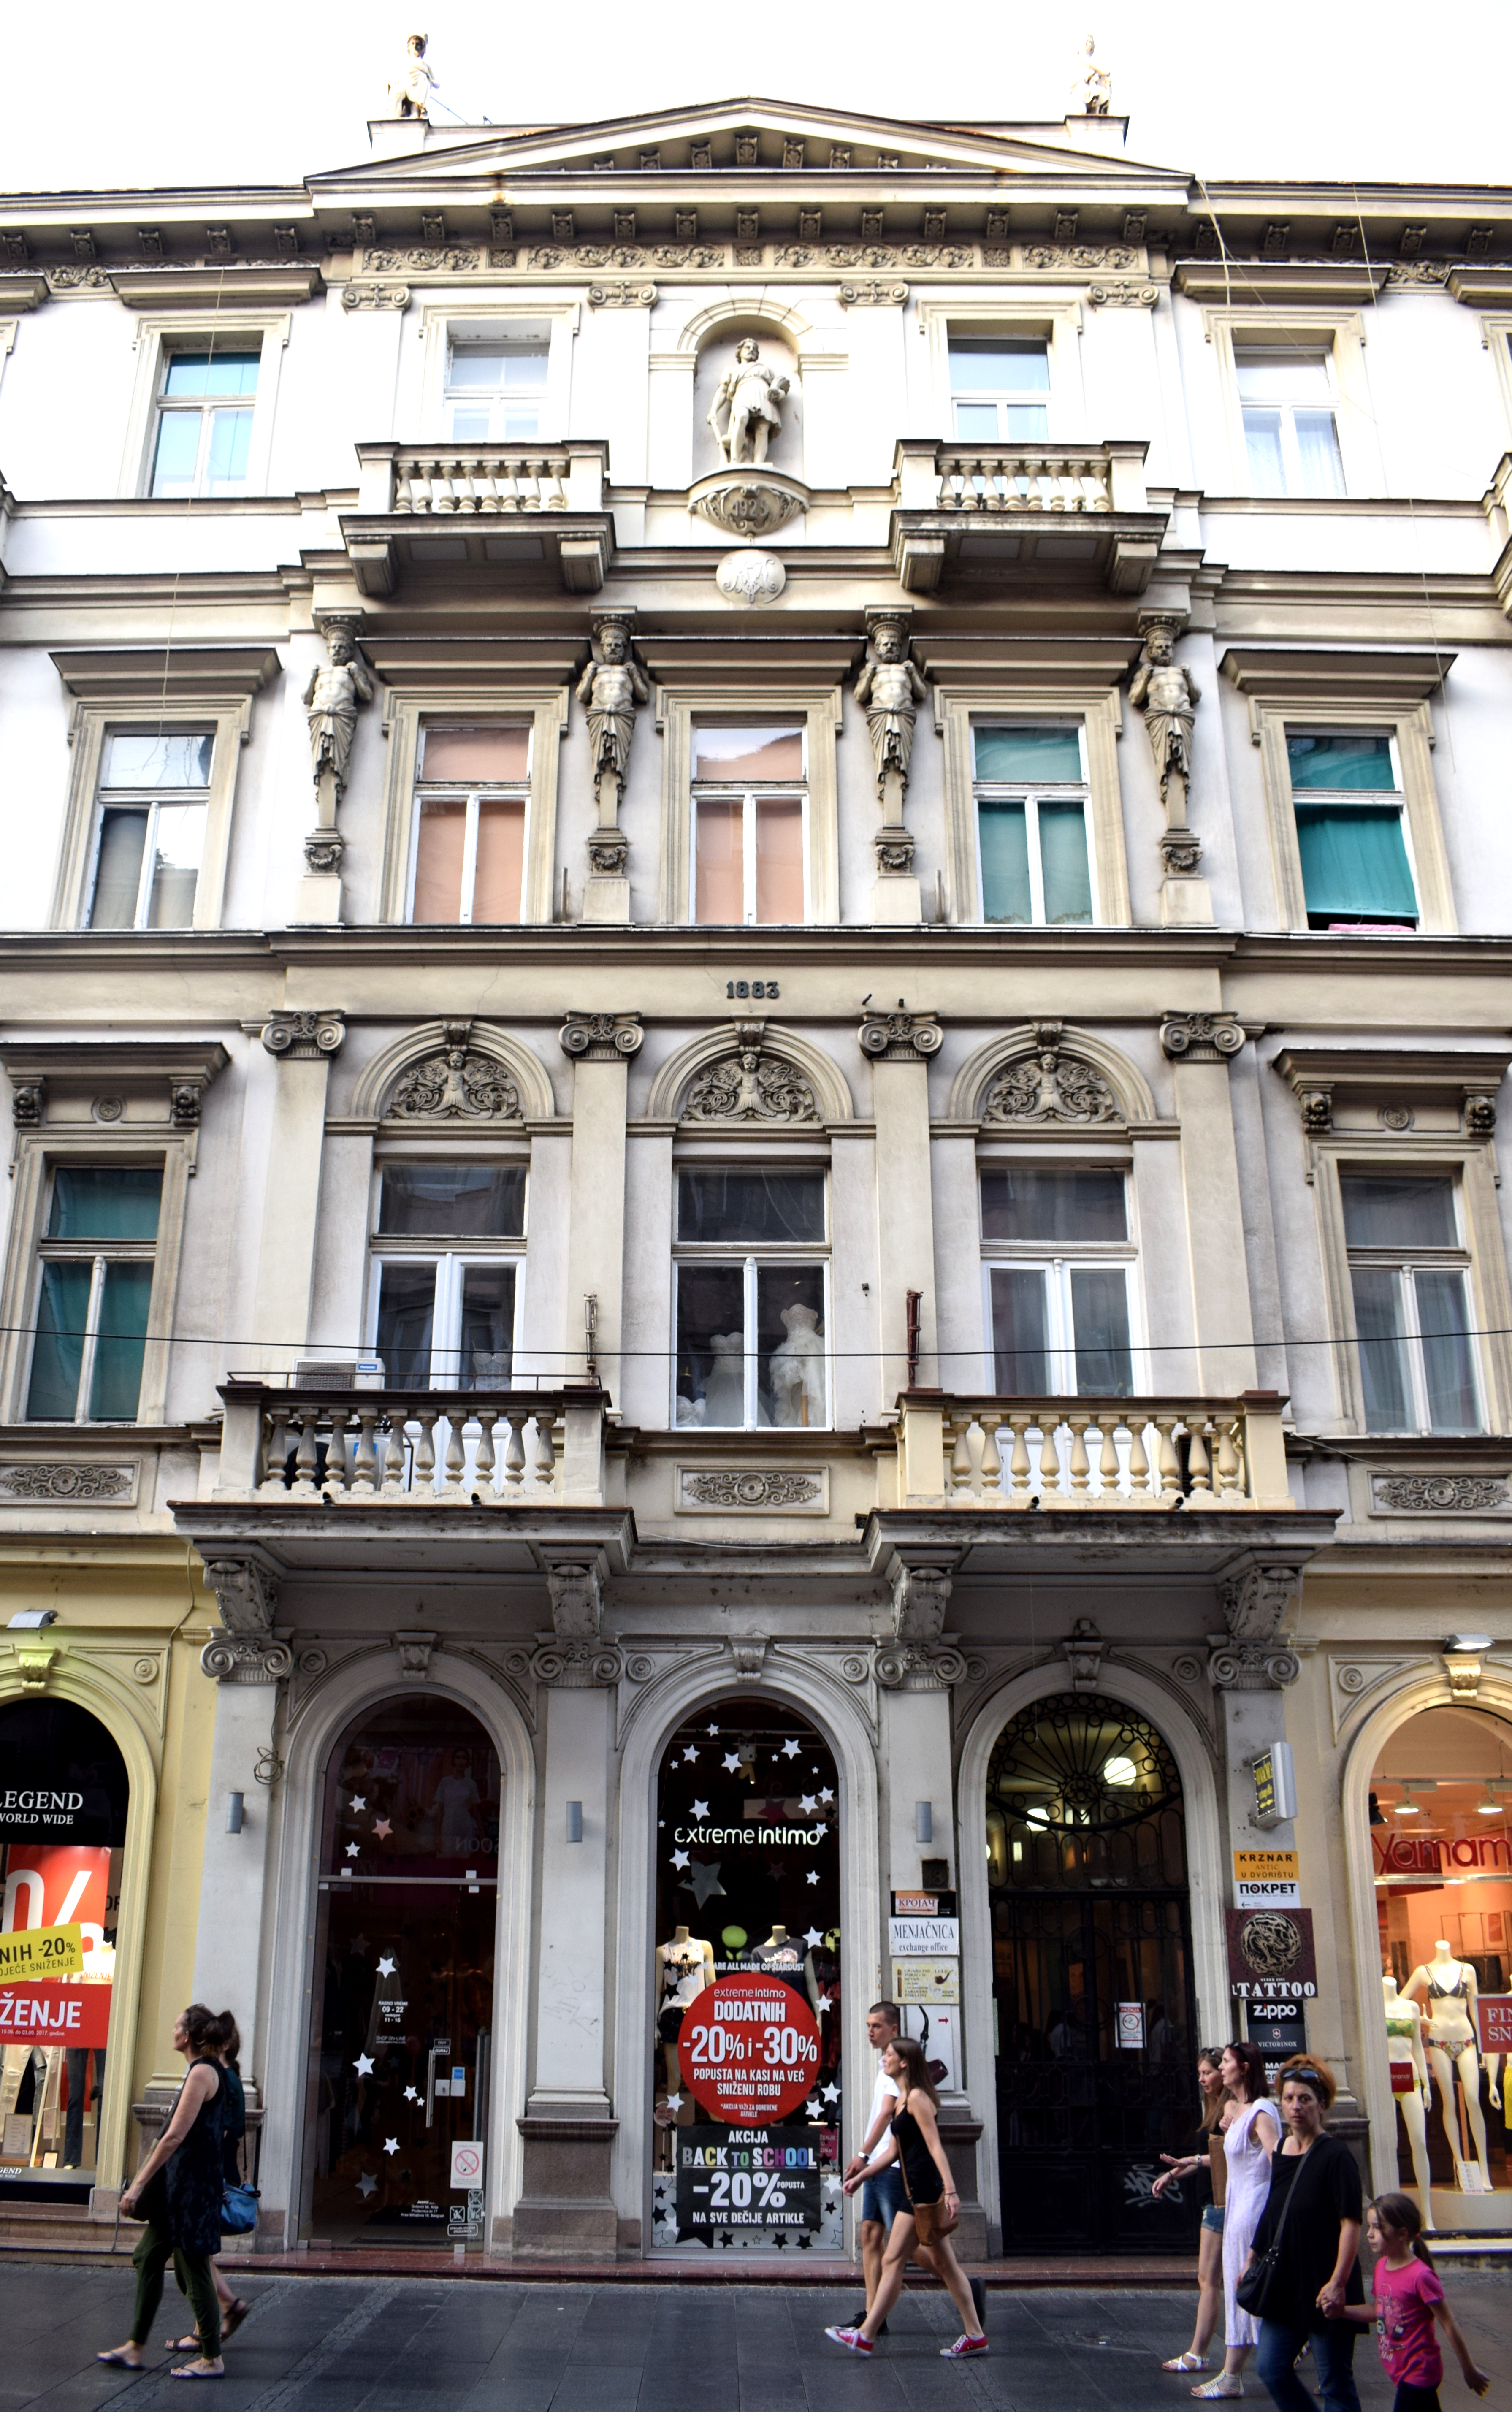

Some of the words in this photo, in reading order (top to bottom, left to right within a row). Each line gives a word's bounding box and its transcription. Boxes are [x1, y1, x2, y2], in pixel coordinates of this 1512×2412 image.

[732, 499, 769, 516] 1925
[727, 981, 779, 998] 1883
[43, 1814, 74, 1824] WIDE
[675, 1825, 755, 1844] extreme
[758, 1826, 820, 1846] intimo
[1240, 1854, 1293, 1862] KRZNAR
[1240, 1884, 1296, 1894] ПОКРЕТ
[894, 1921, 954, 1939] MENJAČNICA
[38, 1937, 75, 1957] -20%
[899, 1943, 928, 1953] exchange
[930, 1943, 948, 1951] office
[30, 1957, 75, 1972] SNIŽENJE
[714, 1962, 726, 1970] ARE
[727, 1962, 739, 1970] ALL
[740, 1962, 760, 1971] MADE
[761, 1962, 771, 1971] OF
[772, 1962, 804, 1971] STARDUST
[713, 1988, 754, 1998] extreme
[755, 1988, 786, 1998] intimo
[1237, 1981, 1315, 1997] TATTOO
[714, 2000, 786, 2022] DODATNIH
[1253, 2003, 1297, 2019] zippo
[683, 2025, 745, 2063] -20%
[748, 2038, 752, 2057] i
[756, 2026, 817, 2065] -30%
[694, 2068, 733, 2081] POPUSTA
[735, 2069, 747, 2081] NA
[750, 2069, 770, 2081] KASI
[773, 2070, 785, 2082] NA
[788, 2068, 805, 2083] VEĆ
[717, 2081, 755, 2096] SNIŽENU
[757, 2084, 781, 2096] ROBU
[728, 2130, 769, 2144] AKCIJA
[682, 2146, 728, 2167] BACK
[731, 2151, 750, 2167] TO
[752, 2147, 817, 2167] SCHOOL
[693, 2171, 786, 2208] -20%
[777, 2181, 805, 2190] POPUSTA
[692, 2212, 706, 2223] NA
[710, 2212, 728, 2224] SVE
[731, 2210, 762, 2224] DEČIJE
[766, 2212, 804, 2224] ARTIKLE
